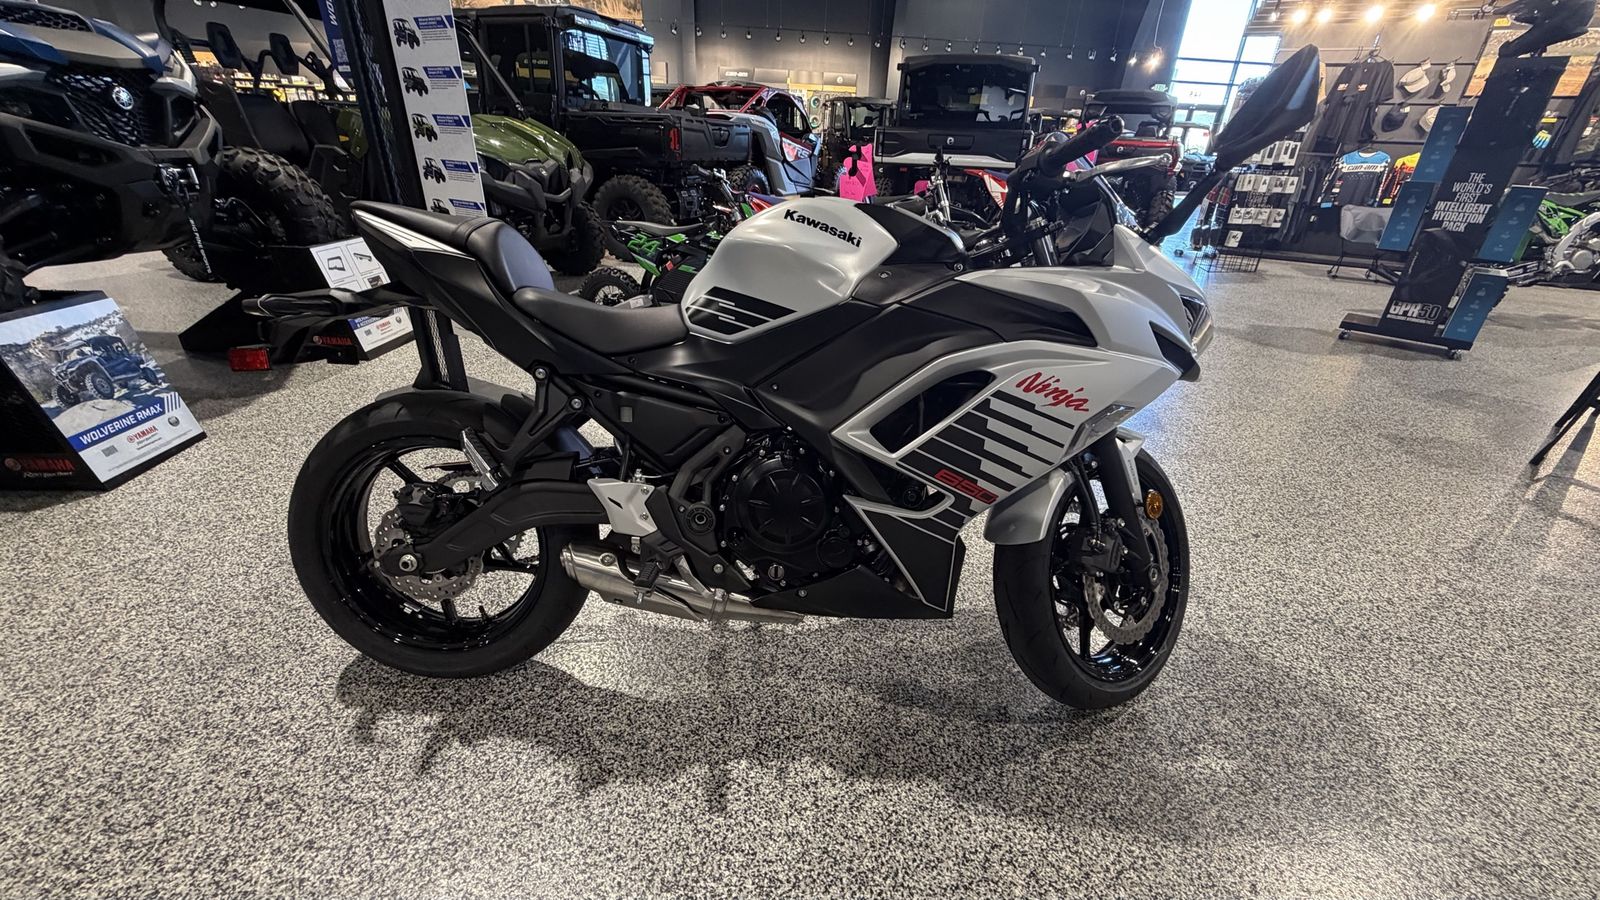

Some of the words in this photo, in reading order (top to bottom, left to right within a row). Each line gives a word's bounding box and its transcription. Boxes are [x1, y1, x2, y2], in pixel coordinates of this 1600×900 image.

[326, 0, 339, 27] WO
[1468, 172, 1487, 184] THE
[1452, 182, 1493, 195] WORLD'S
[1454, 192, 1481, 203] FIRST
[1434, 200, 1493, 215] INTELLIGENT
[1431, 210, 1486, 225] HYDRATION
[783, 208, 863, 249] Kawasaki
[1441, 221, 1468, 233] PACK
[1015, 371, 1089, 412] Ninja
[79, 416, 137, 446] WOLVERINE
[138, 403, 163, 424] RMAX
[133, 425, 159, 441] YAMAHA
[19, 457, 76, 472] YAMAHA
[934, 468, 999, 505] 650
